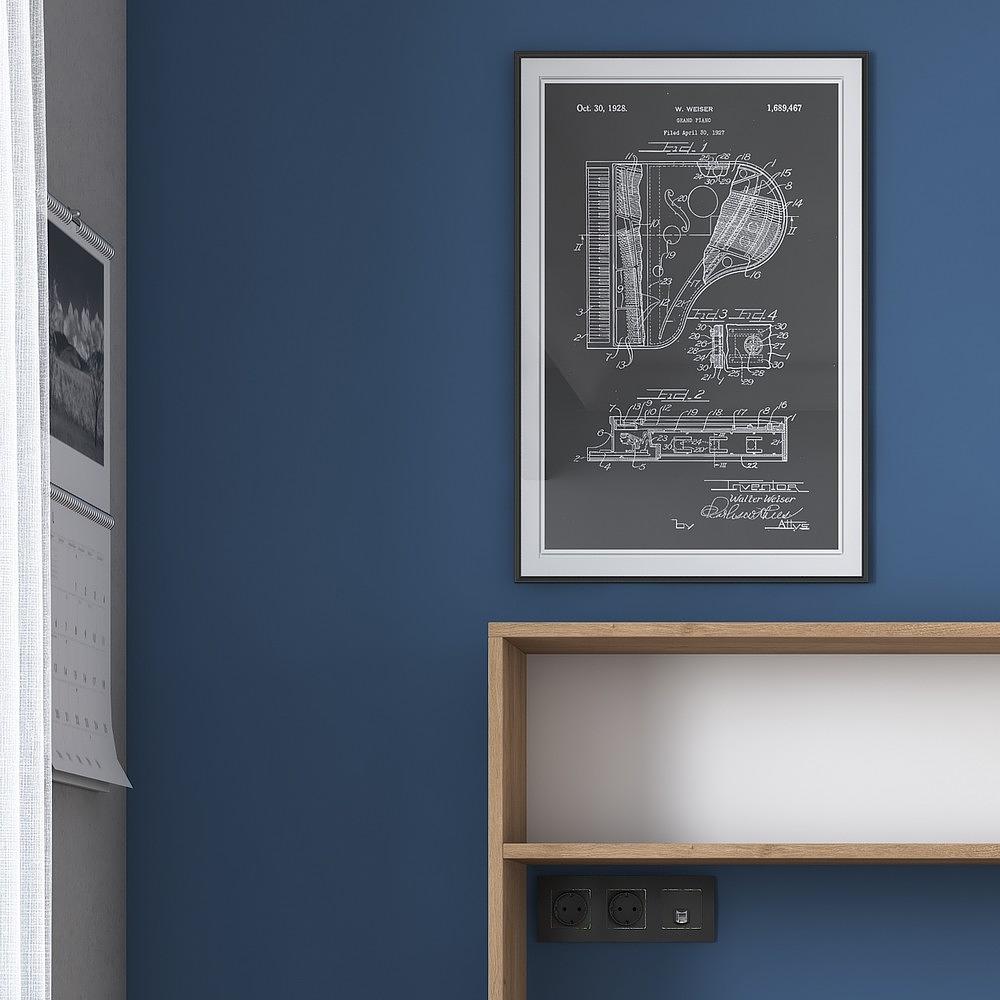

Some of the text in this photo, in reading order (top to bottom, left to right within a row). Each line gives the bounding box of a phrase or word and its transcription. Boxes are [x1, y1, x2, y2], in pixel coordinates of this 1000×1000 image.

[576, 104, 628, 113] Oct. 30, 1928.
[766, 104, 803, 113] 1,689,467
